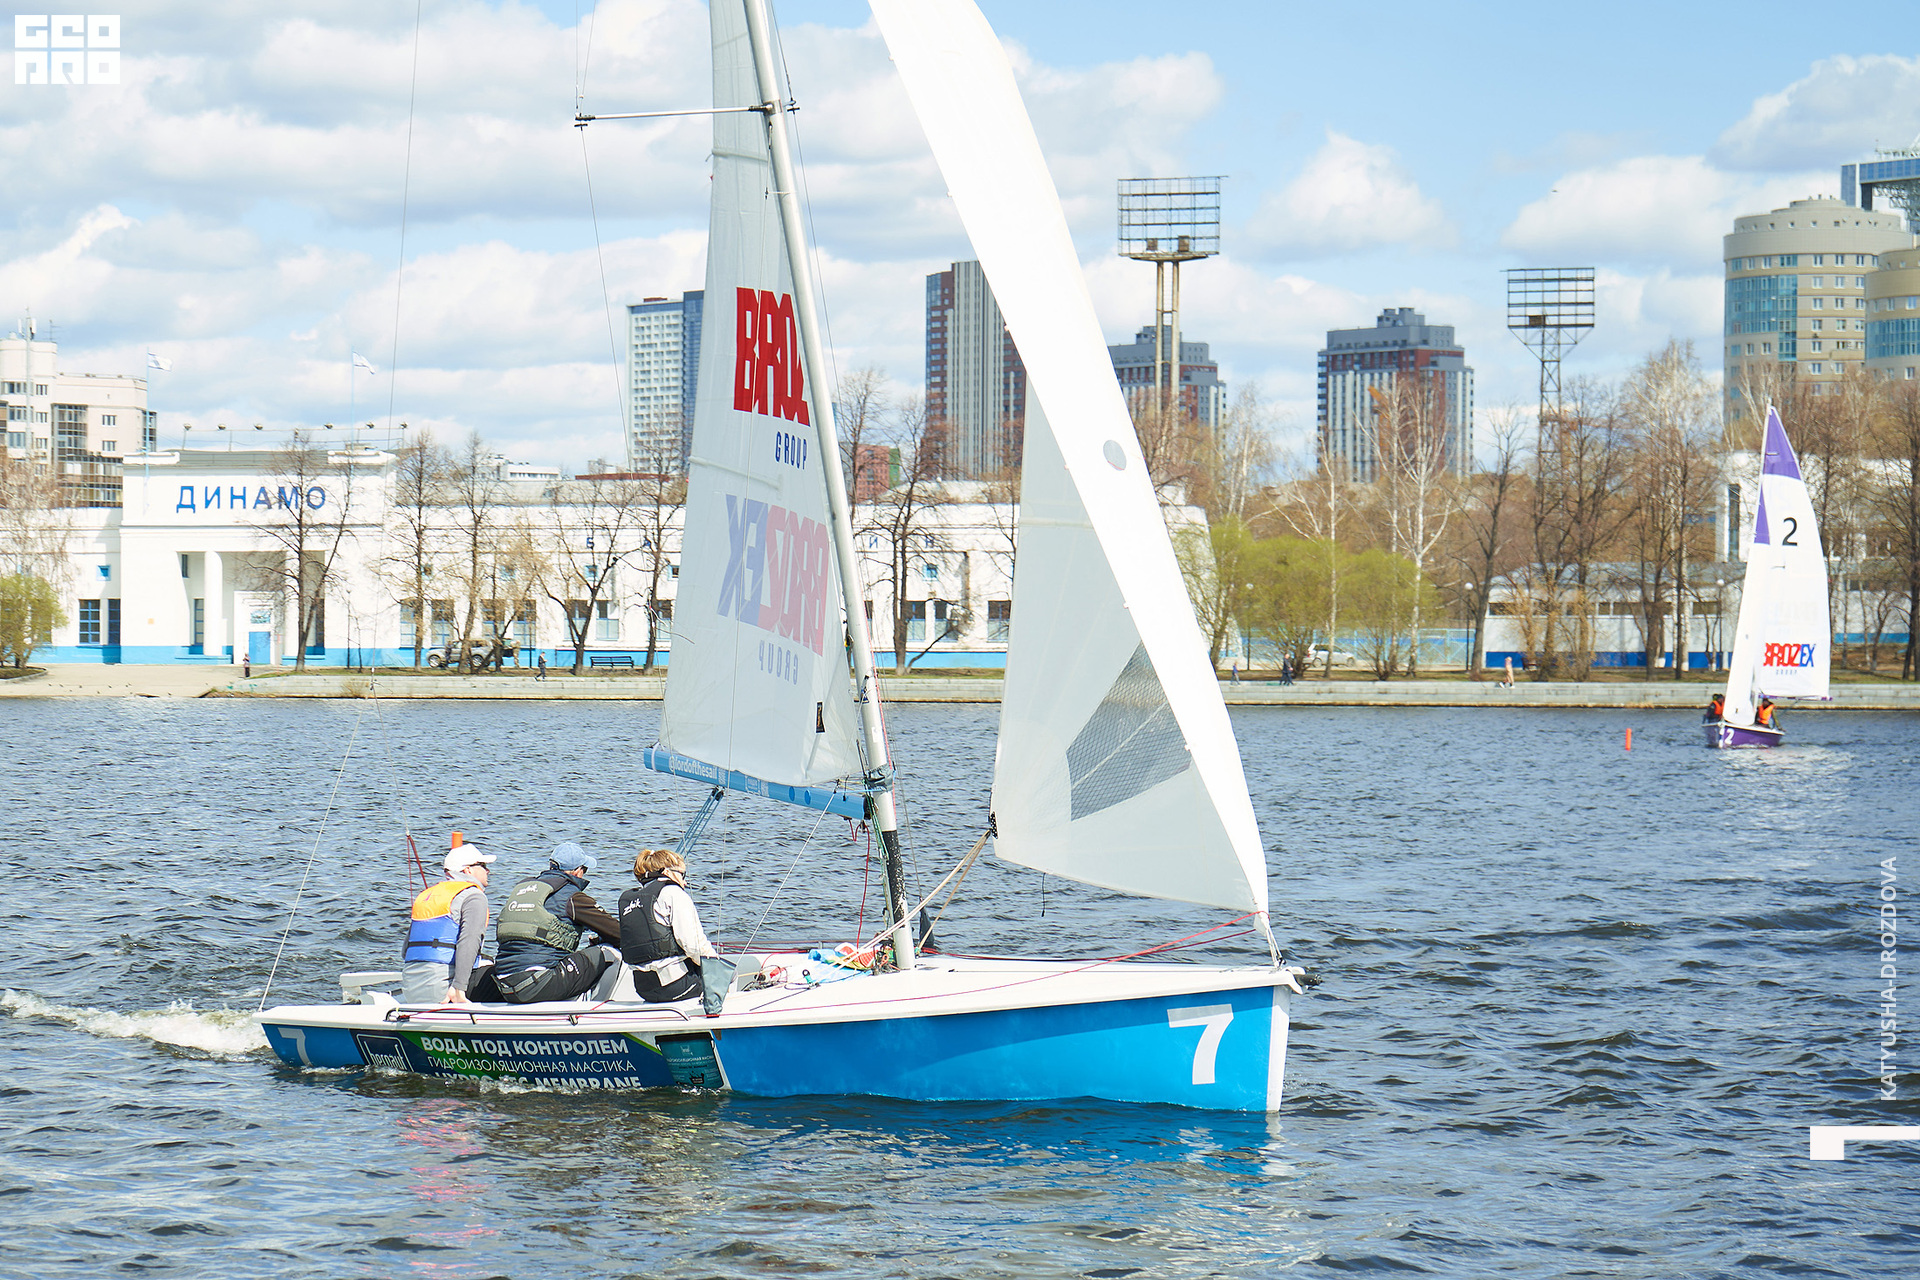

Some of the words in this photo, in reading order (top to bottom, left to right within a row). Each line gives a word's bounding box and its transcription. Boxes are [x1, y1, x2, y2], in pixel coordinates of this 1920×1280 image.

[775, 431, 807, 470] GROUP
[176, 485, 326, 513] ДИНАМО
[1782, 517, 1798, 546] 2
[1724, 728, 1735, 745] 2
[278, 1027, 314, 1067] 7
[420, 1036, 471, 1056] ВОДА
[471, 1039, 512, 1058] ПОД
[512, 1038, 629, 1056] КОНТРОЛЕМ
[1166, 1003, 1234, 1085] 7
[427, 1055, 568, 1073] ГИДРОИЗОЛЯЦИОННАЯ
[569, 1059, 637, 1073] МАСТИКА
